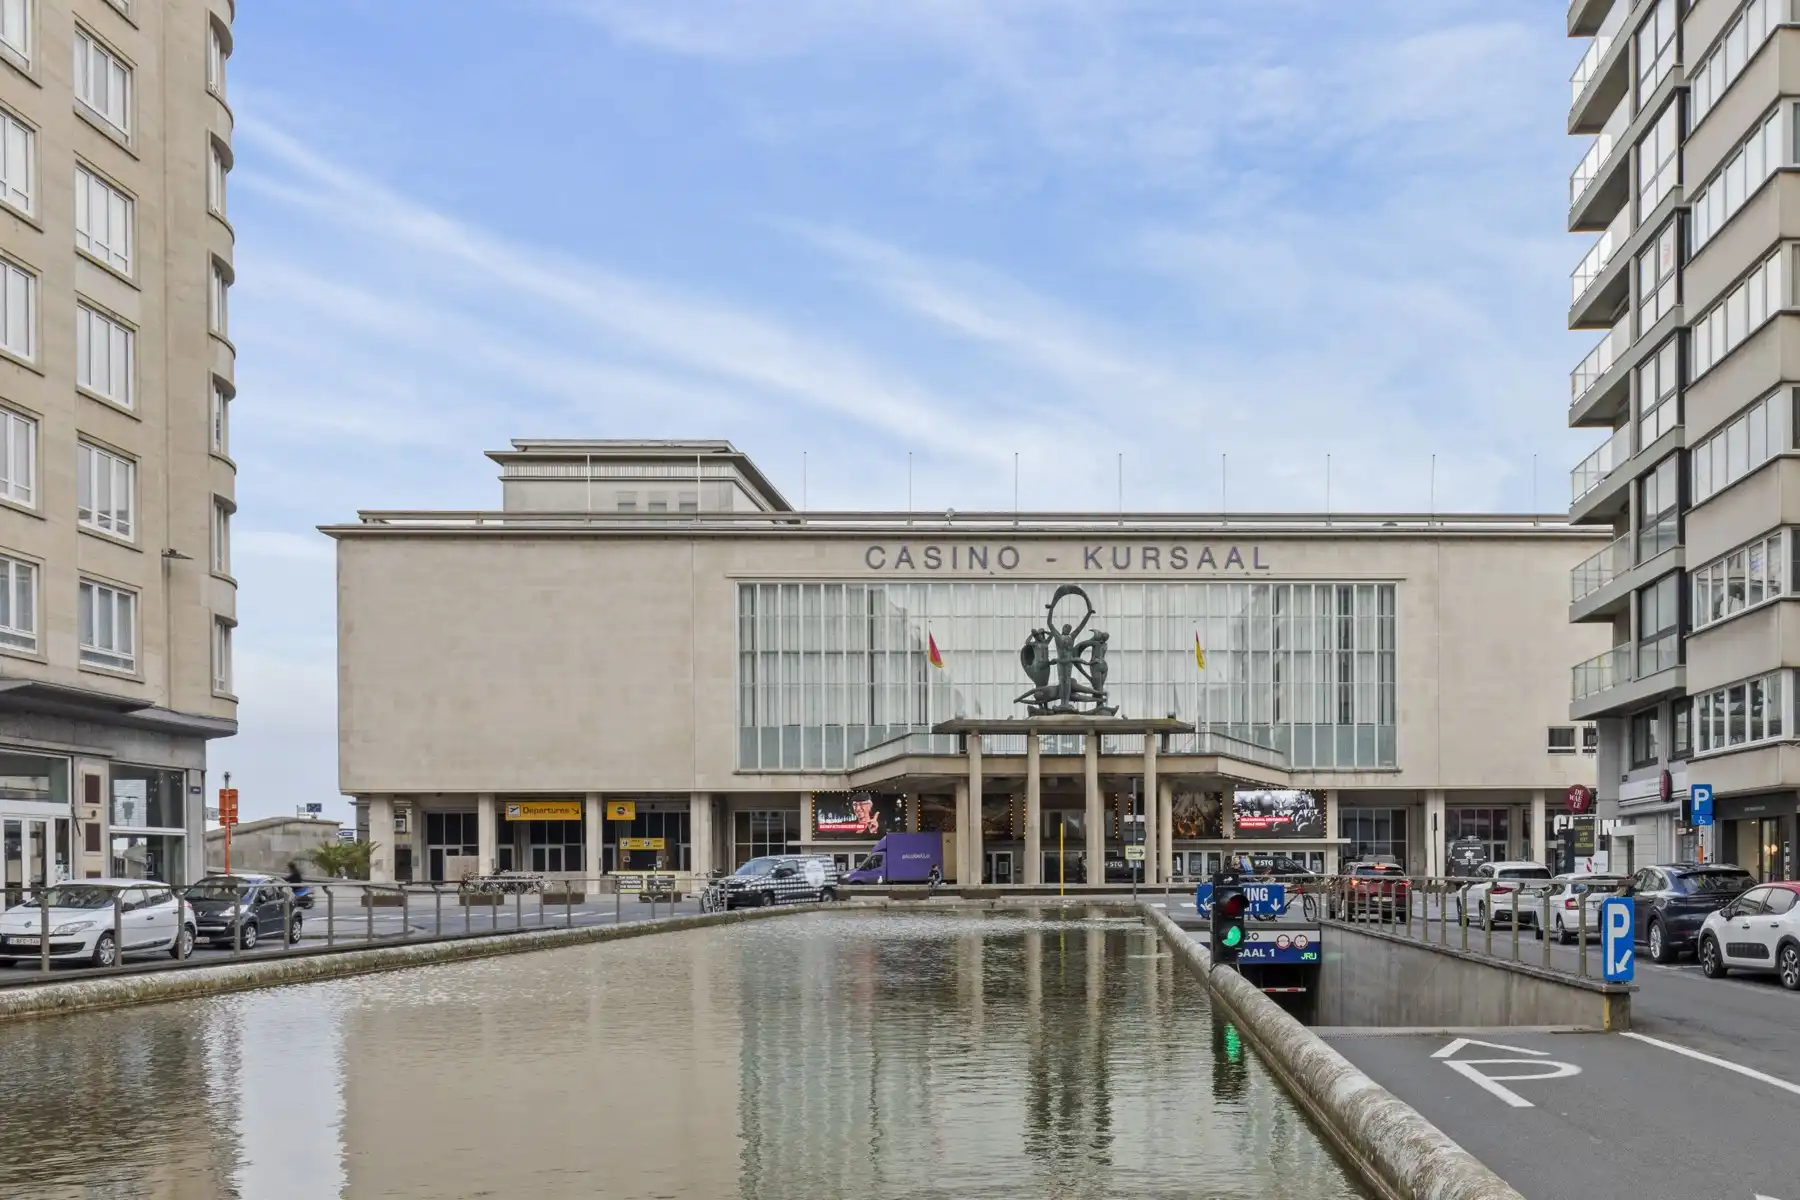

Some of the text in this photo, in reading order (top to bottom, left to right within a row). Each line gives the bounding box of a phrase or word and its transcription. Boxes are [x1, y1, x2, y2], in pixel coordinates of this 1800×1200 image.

[865, 545, 1020, 570] CASINO
[1084, 545, 1269, 570] KURSAAL
[1574, 788, 1584, 796] DE
[1694, 788, 1709, 810] P
[522, 806, 570, 815] Departures
[1244, 887, 1269, 902] ING
[1255, 903, 1260, 912] 1
[1607, 903, 1631, 975] P
[1269, 948, 1276, 958] 1
